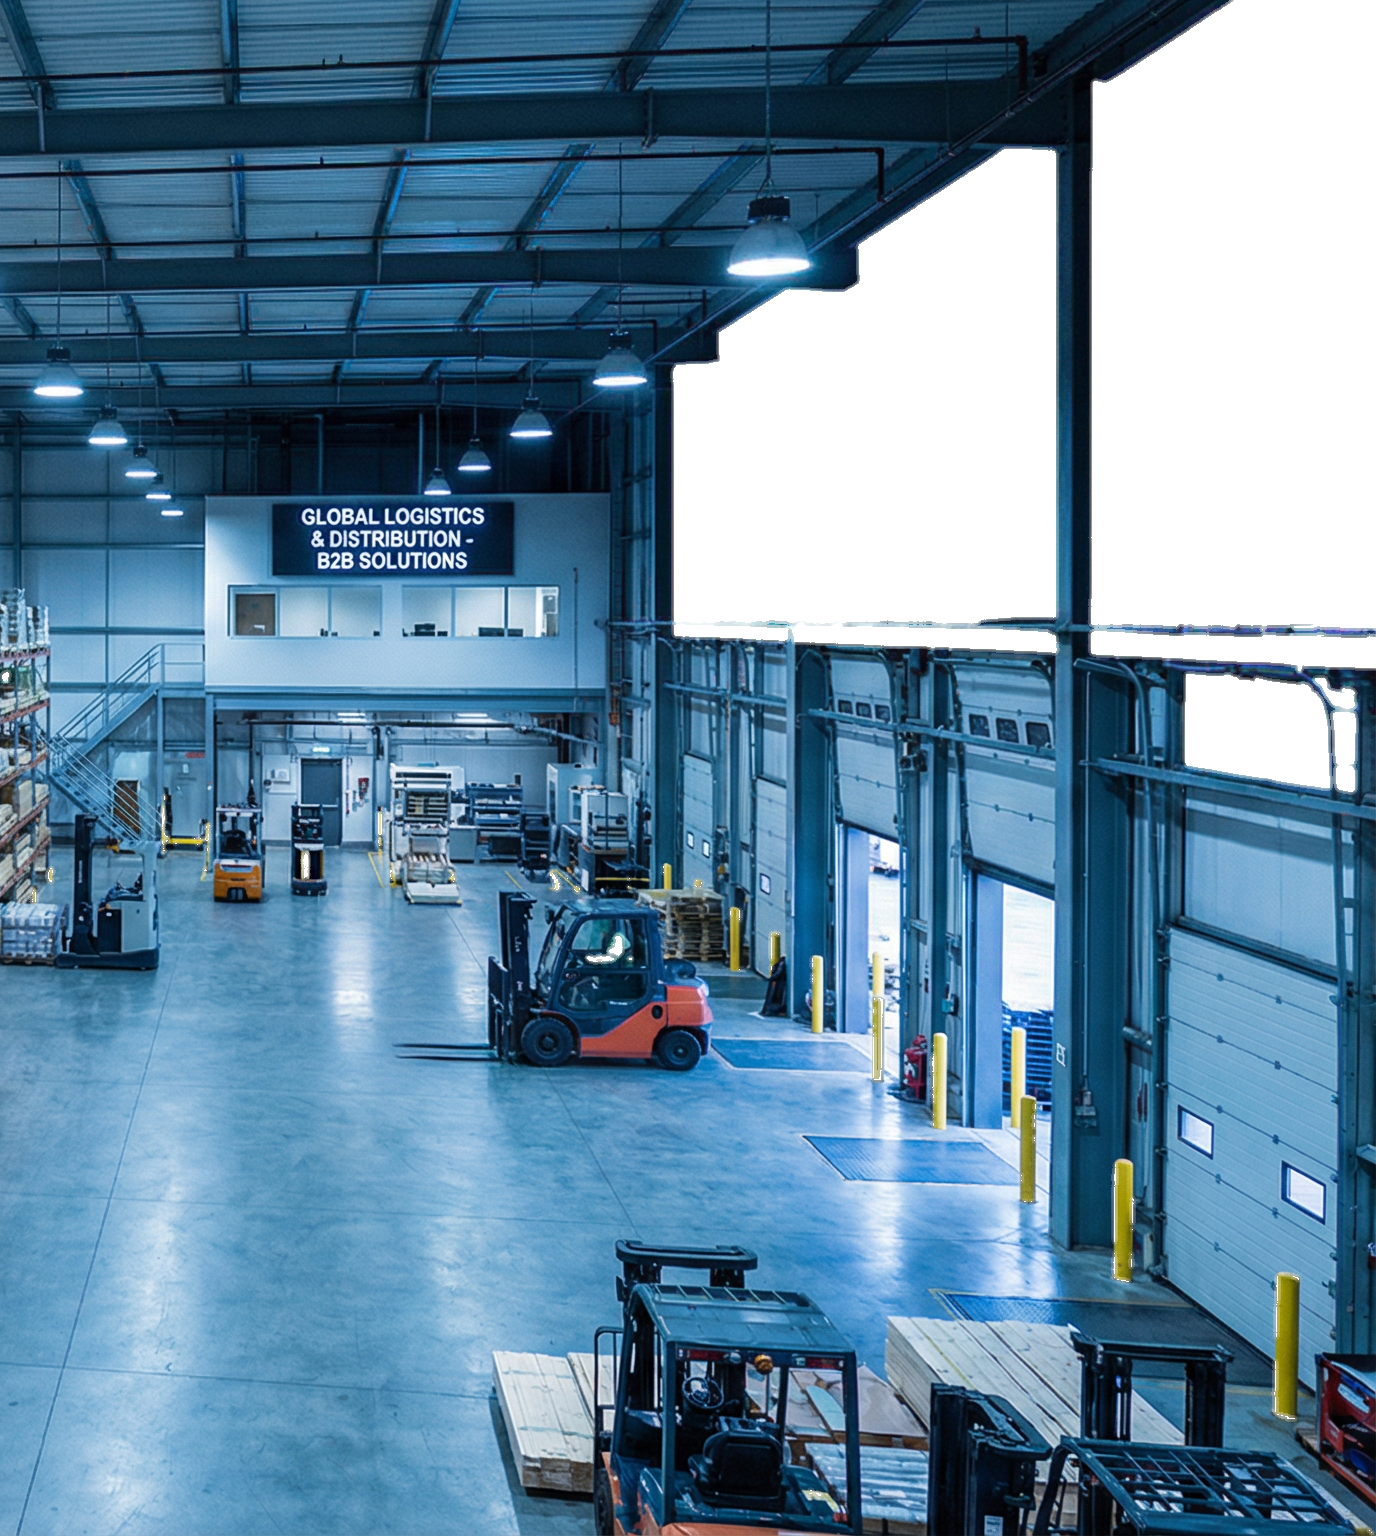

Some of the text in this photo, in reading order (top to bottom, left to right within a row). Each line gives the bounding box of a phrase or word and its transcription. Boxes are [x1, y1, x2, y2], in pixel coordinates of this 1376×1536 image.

[301, 507, 485, 526] GLOBAL LOGISTICS
[310, 529, 325, 548] &
[329, 529, 461, 548] DISTRIBUTION
[317, 551, 468, 570] B2B SOLUTIONS
